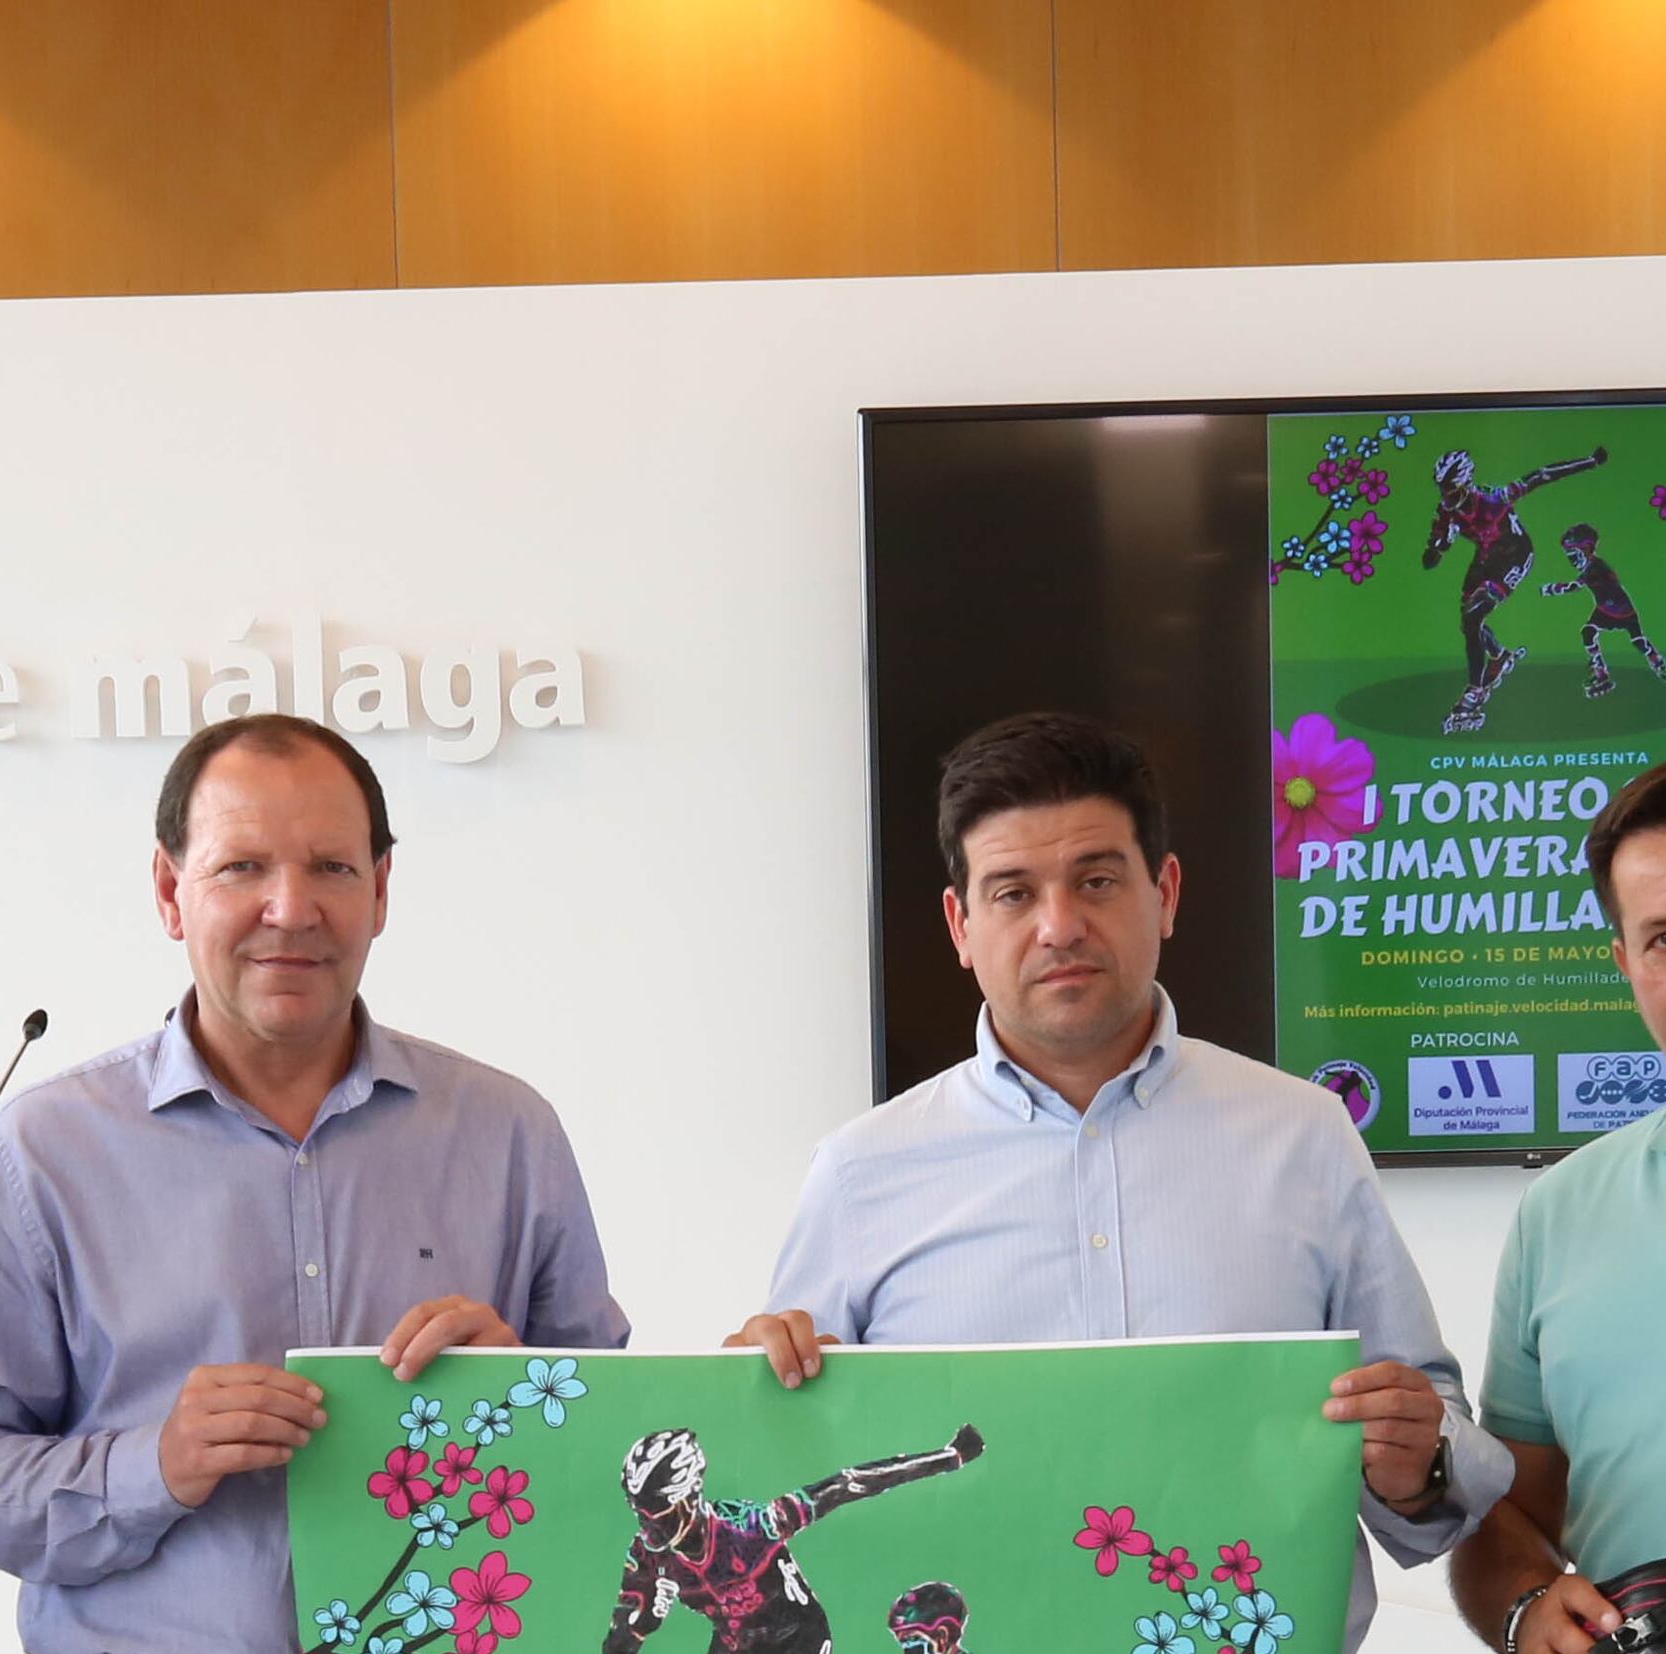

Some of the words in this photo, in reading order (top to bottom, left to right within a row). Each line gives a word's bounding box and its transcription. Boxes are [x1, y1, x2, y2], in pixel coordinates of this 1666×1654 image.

[68, 611, 588, 766] málaga
[1430, 756, 1466, 769] CPV
[1472, 753, 1548, 768] MÁLAGA
[1554, 752, 1649, 766] PRESENTA
[1363, 784, 1377, 825] I
[1392, 776, 1609, 825] TORNEO
[1300, 895, 1370, 938] DE
[1361, 949, 1464, 966] DOMINGO
[1485, 948, 1505, 962] 15
[1513, 947, 1541, 962] DE
[1548, 945, 1611, 961] MAYO
[1417, 975, 1510, 989] Velodromo
[1516, 974, 1537, 988] de
[1304, 1003, 1336, 1018] Más
[1339, 1003, 1440, 1018] información:
[1411, 1032, 1520, 1048] PATROCINA
[1414, 1106, 1474, 1119] Diputación
[1475, 1104, 1529, 1118] Provincial
[1443, 1119, 1458, 1131] de
[1462, 1118, 1501, 1132] Málaga
